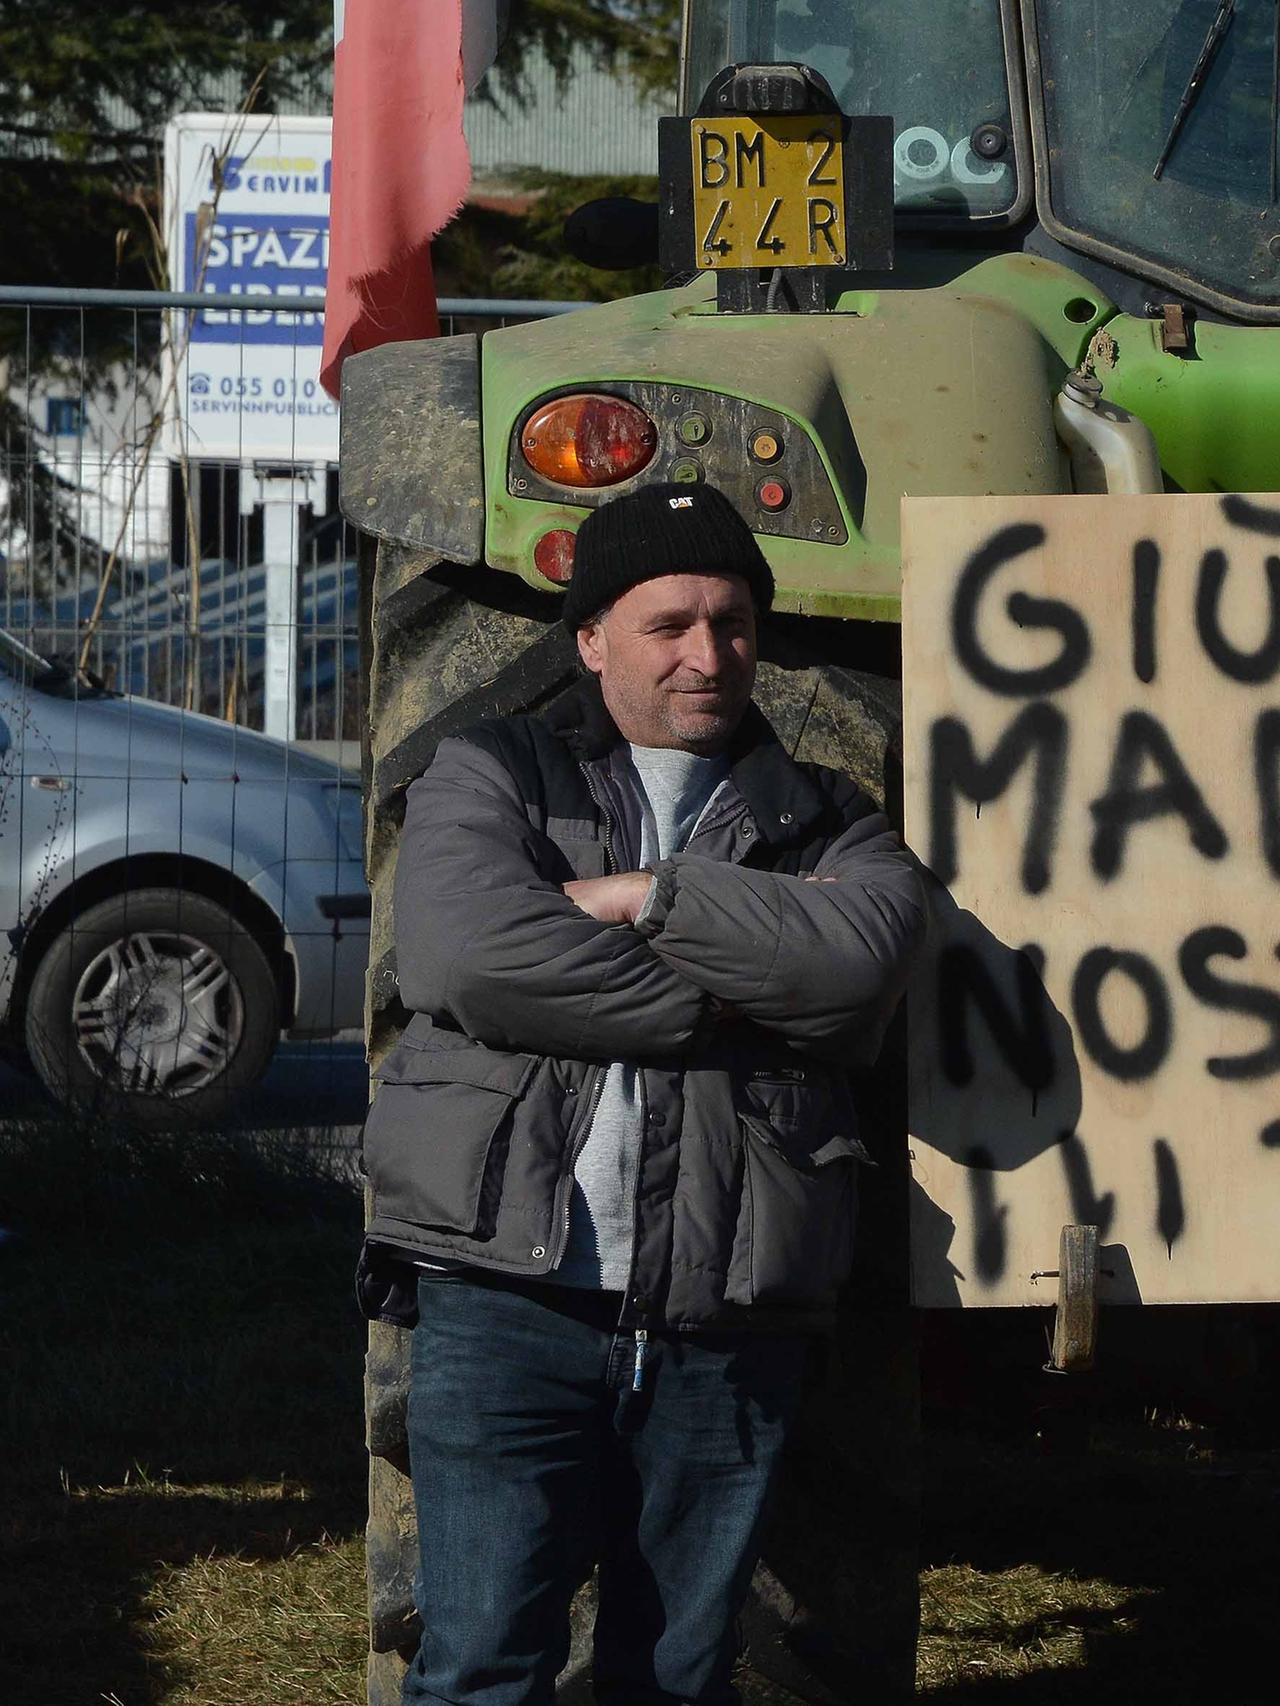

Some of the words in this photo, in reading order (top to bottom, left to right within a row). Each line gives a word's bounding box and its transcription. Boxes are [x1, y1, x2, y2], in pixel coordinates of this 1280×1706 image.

[701, 131, 765, 188] BM
[807, 131, 836, 185] 2
[220, 377, 262, 396] 055
[669, 497, 694, 509] CAT
